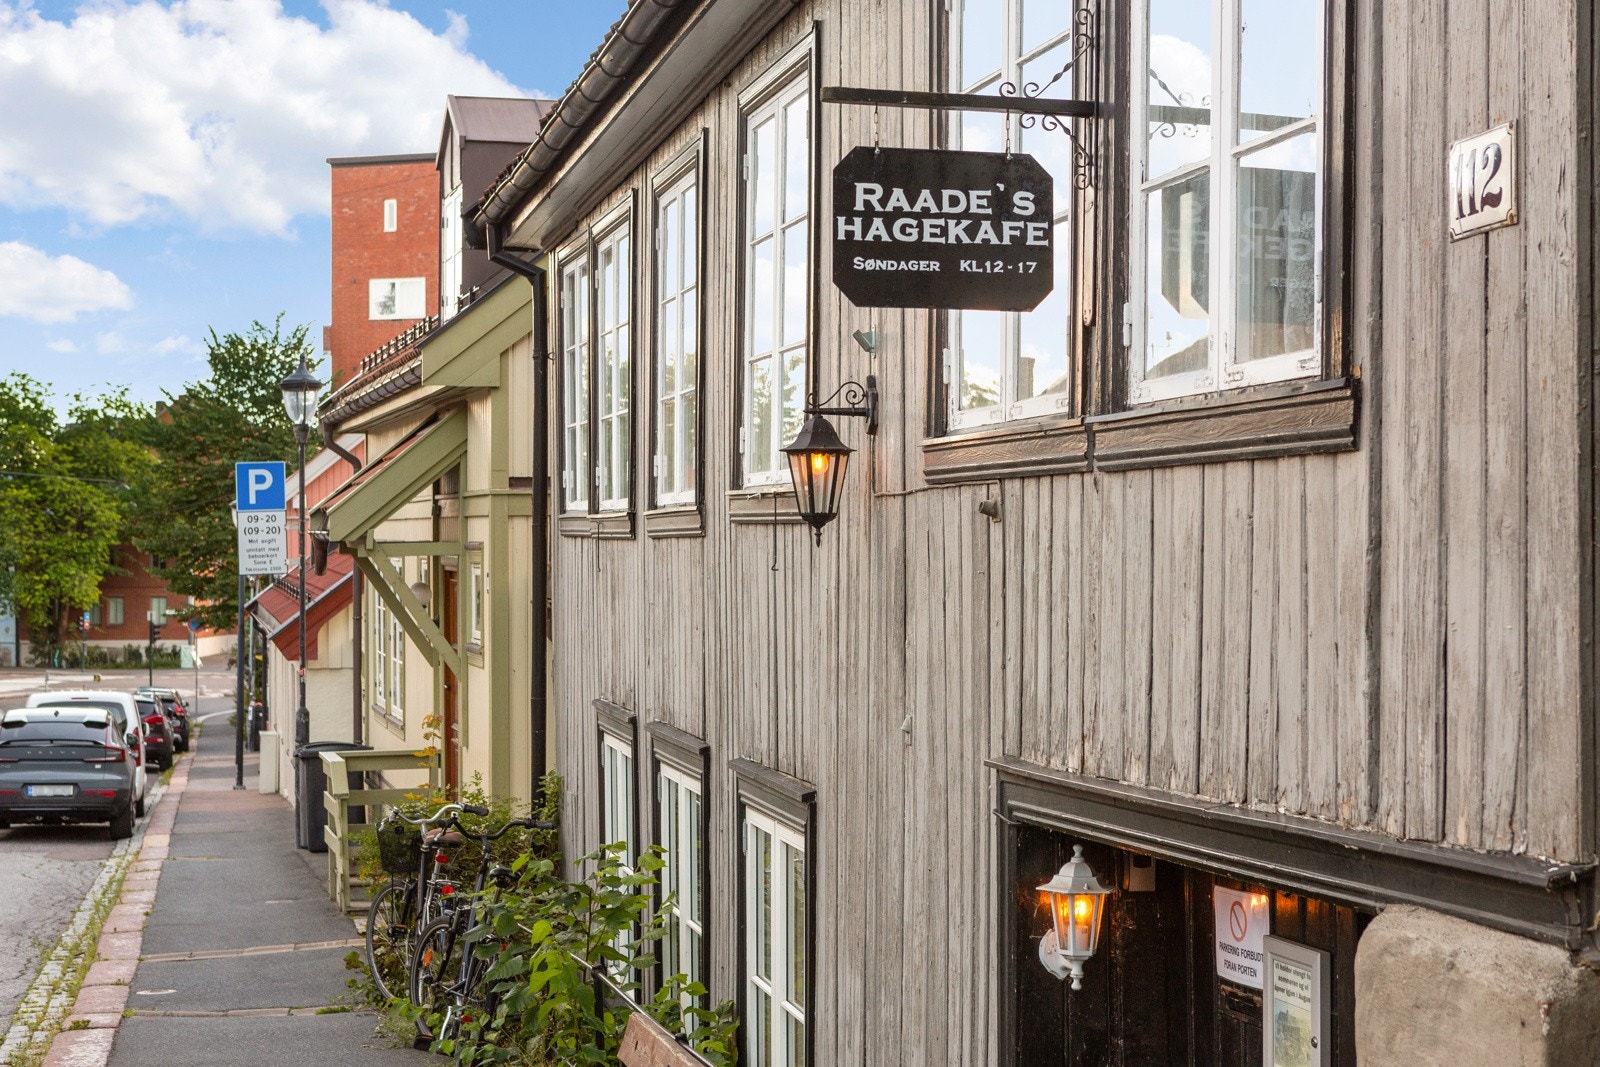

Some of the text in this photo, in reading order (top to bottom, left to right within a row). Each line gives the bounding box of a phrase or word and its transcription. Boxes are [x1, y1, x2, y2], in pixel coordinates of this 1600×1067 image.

[1456, 143, 1503, 220] 112
[836, 216, 1049, 247] HAGEKAFE
[249, 469, 273, 504] P
[1219, 941, 1240, 957] PARKERING
[1224, 959, 1257, 978] FORAN PORTEN
